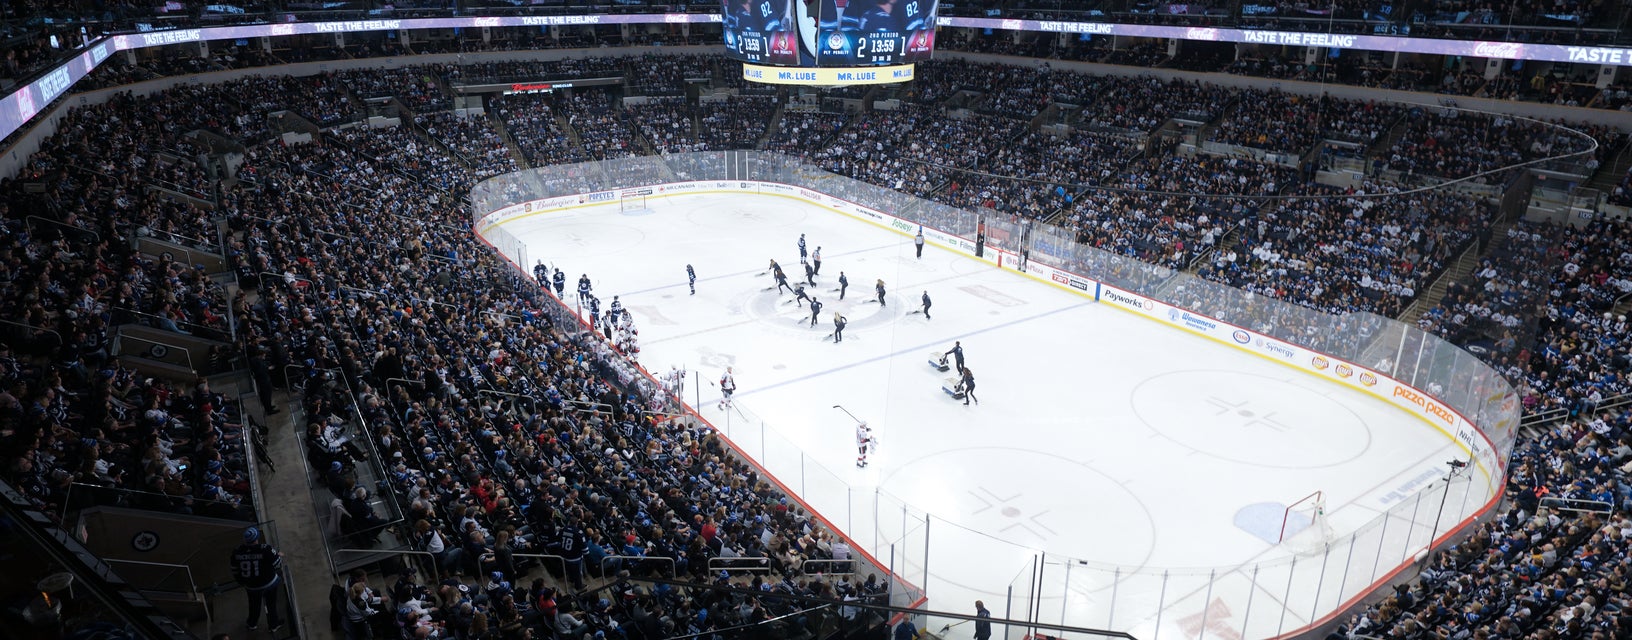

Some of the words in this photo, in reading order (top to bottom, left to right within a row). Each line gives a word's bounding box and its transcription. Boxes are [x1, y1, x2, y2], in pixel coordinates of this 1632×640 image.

[760, 1, 773, 18] 82
[906, 1, 919, 17] 82
[314, 22, 342, 33] TASTE
[343, 21, 362, 31] THE
[522, 17, 548, 25] TASTE
[549, 16, 565, 24] THE
[1040, 21, 1062, 31] TASTE
[1063, 22, 1078, 32] THE
[143, 33, 163, 45] TASTE
[162, 32, 175, 43] THE
[738, 34, 744, 54] 2
[744, 37, 760, 52] 13:59
[1243, 30, 1279, 43] TASTE
[1280, 32, 1301, 44] THE
[857, 37, 867, 58] 2
[871, 40, 895, 53] 13:59
[899, 36, 906, 56] 1
[1474, 41, 1518, 59] Coca-Cola
[1568, 47, 1622, 63] TASTE
[778, 72, 794, 80] MR.
[795, 72, 817, 80] LUBE
[856, 72, 876, 80] LUBE
[1104, 289, 1143, 309] Payworks
[1265, 342, 1295, 358] Synergy
[1393, 385, 1425, 408] pizza
[1425, 401, 1454, 425] pizza
[561, 536, 574, 551] 18
[239, 560, 260, 578] 91
